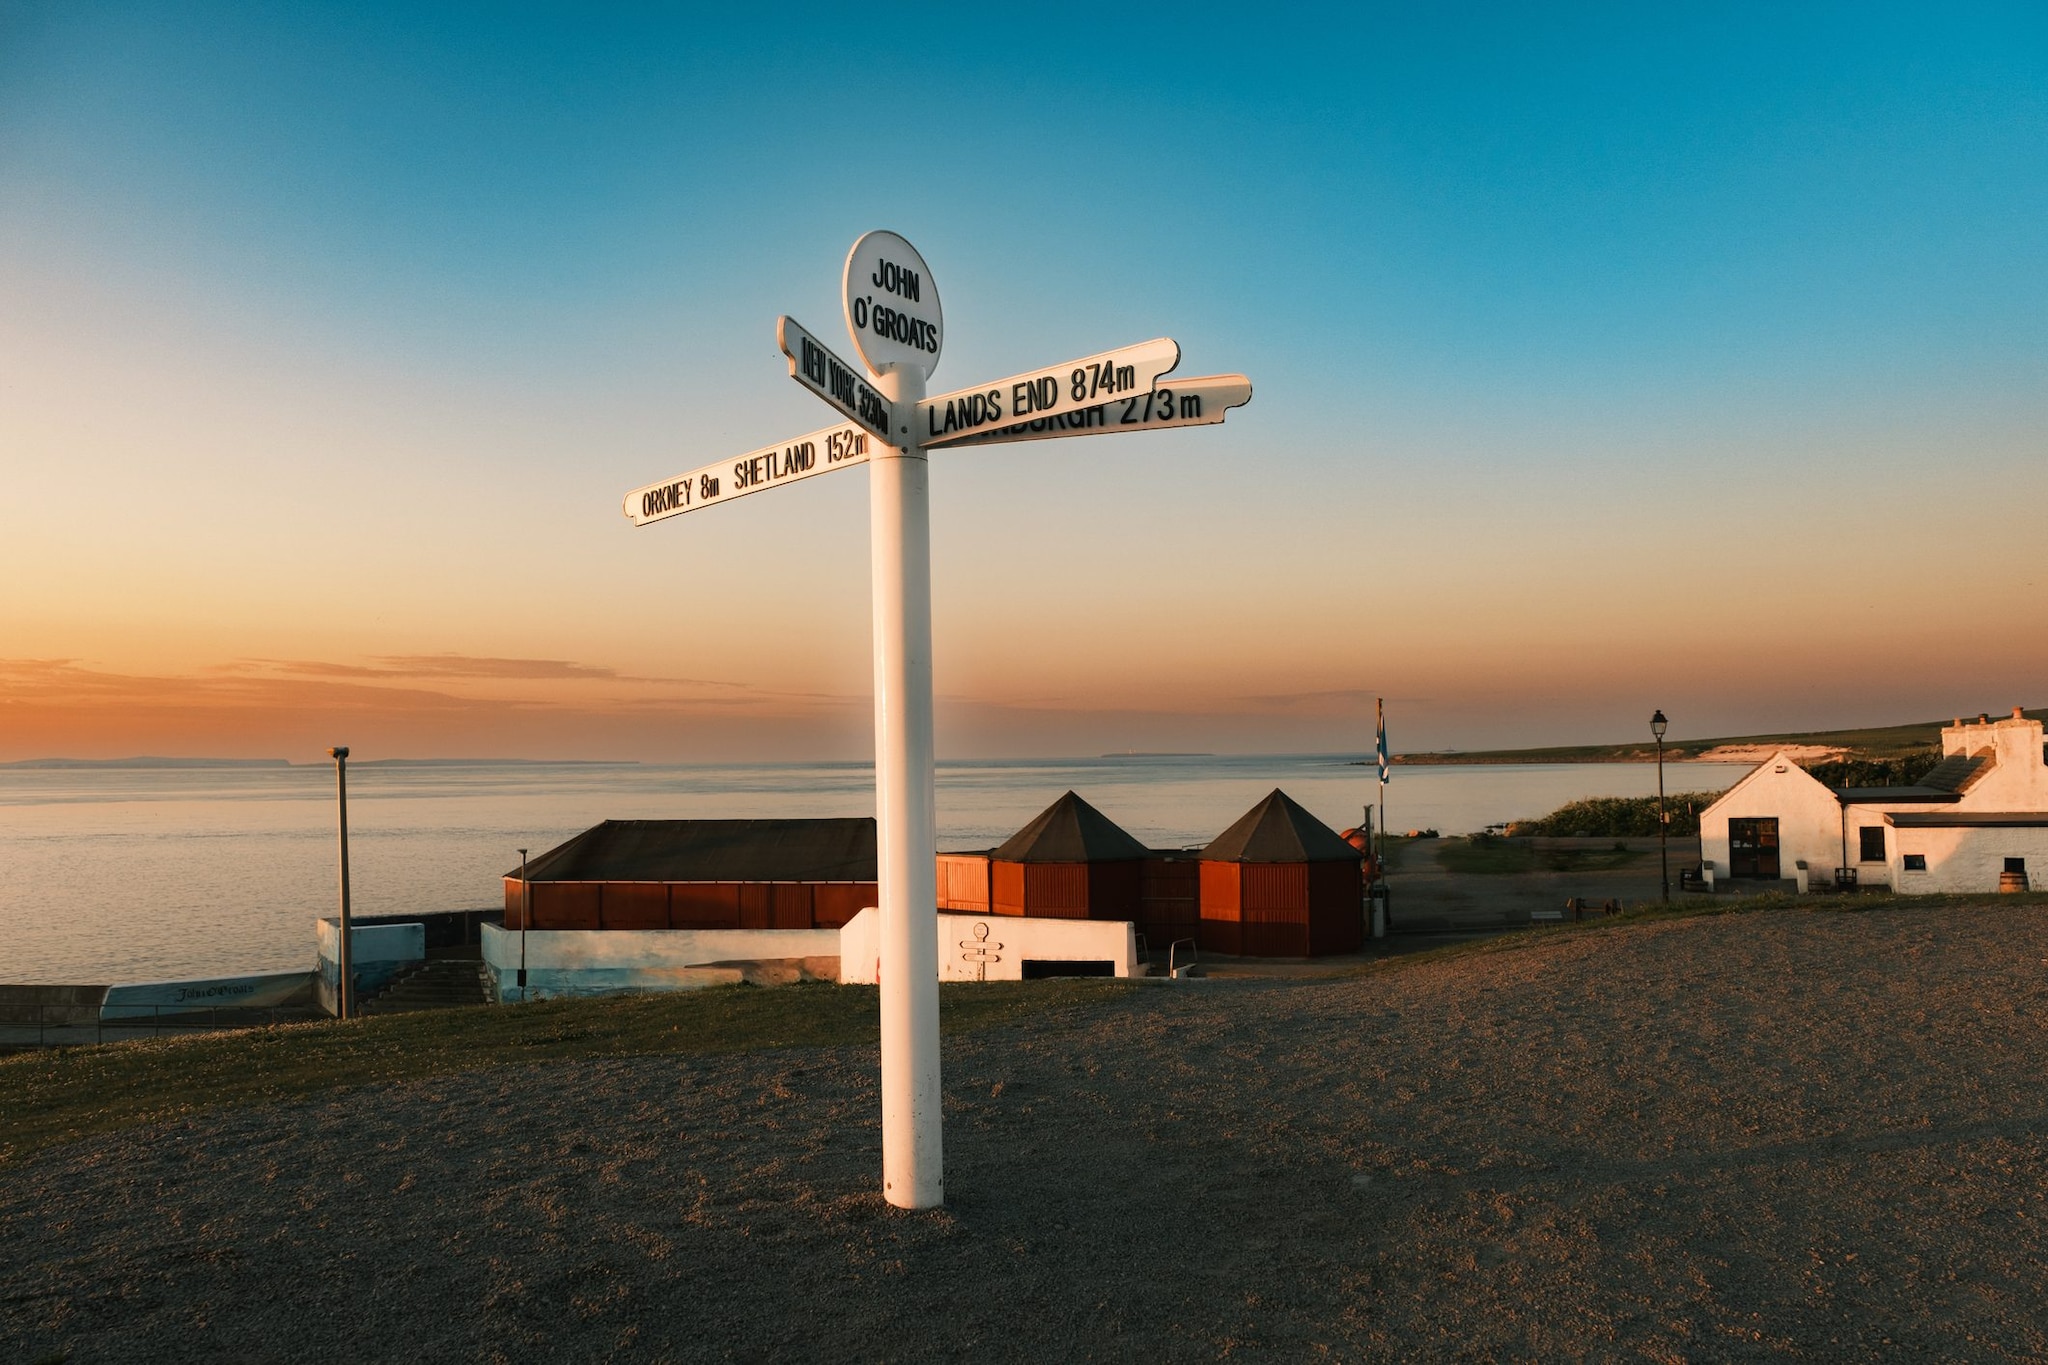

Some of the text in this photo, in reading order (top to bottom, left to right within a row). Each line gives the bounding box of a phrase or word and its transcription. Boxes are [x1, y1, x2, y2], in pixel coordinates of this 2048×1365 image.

[873, 259, 919, 303] JOHN
[855, 296, 937, 353] O'GROATS
[802, 336, 888, 435] NEW YORK 3230m
[929, 361, 1134, 437] LANDS END 874m
[643, 429, 868, 517] ORKNEY 8m SHETLAND 152m
